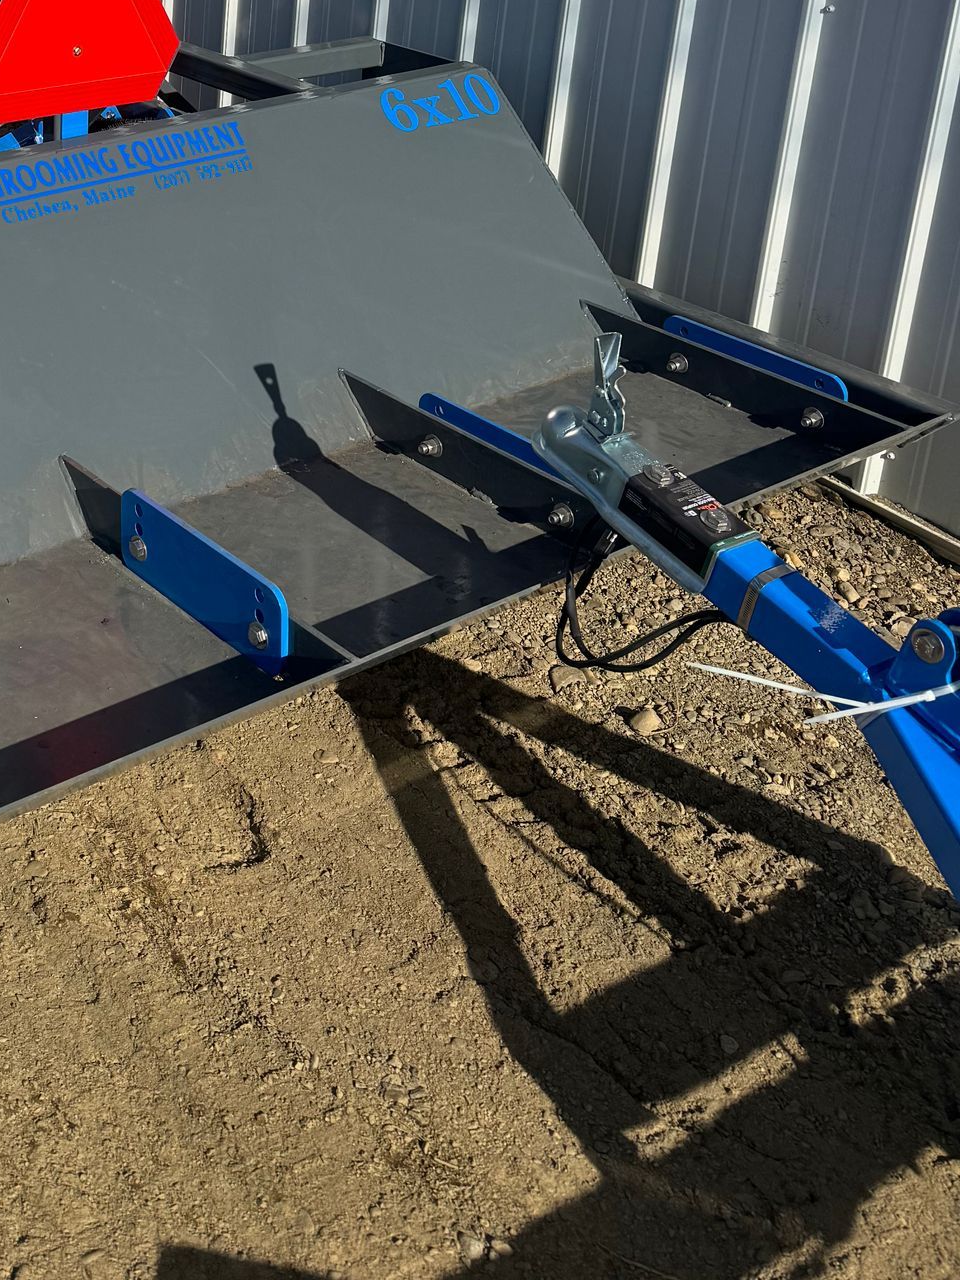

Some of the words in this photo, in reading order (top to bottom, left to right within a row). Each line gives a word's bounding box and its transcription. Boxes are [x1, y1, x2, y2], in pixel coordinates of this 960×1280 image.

[380, 74, 500, 132] 6x10
[117, 121, 245, 169] EQUIPMENT
[82, 185, 136, 207] Maine
